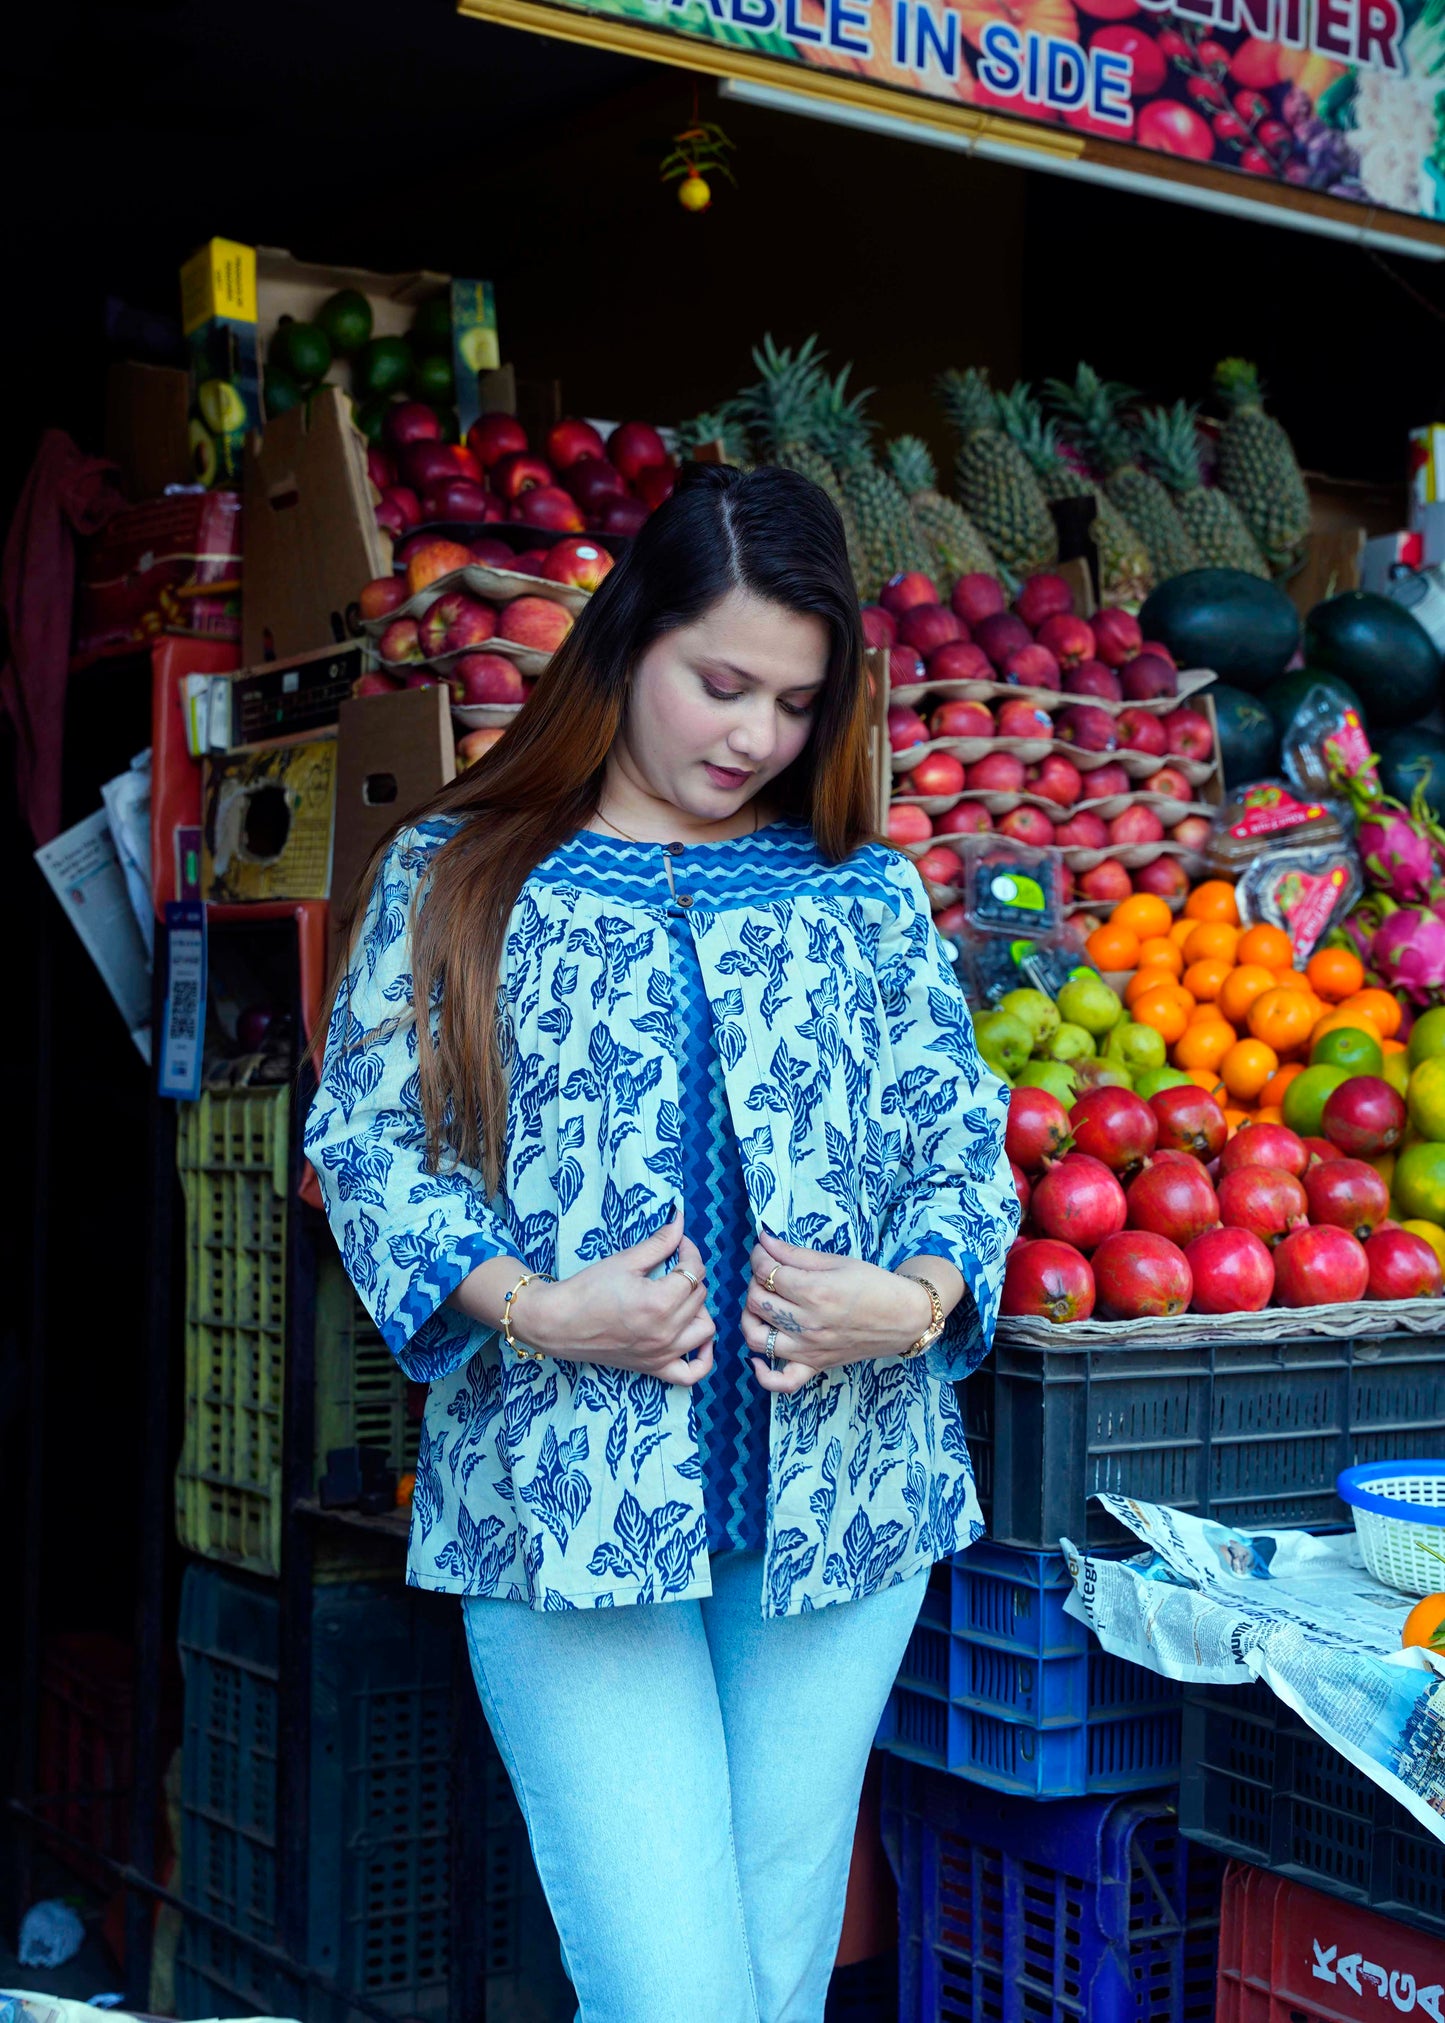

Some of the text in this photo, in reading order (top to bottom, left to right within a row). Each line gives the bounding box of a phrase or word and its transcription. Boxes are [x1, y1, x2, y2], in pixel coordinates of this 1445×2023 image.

[895, 0, 958, 77] IN
[980, 22, 1131, 122] SIDE
[1146, 0, 1402, 70] NTER
